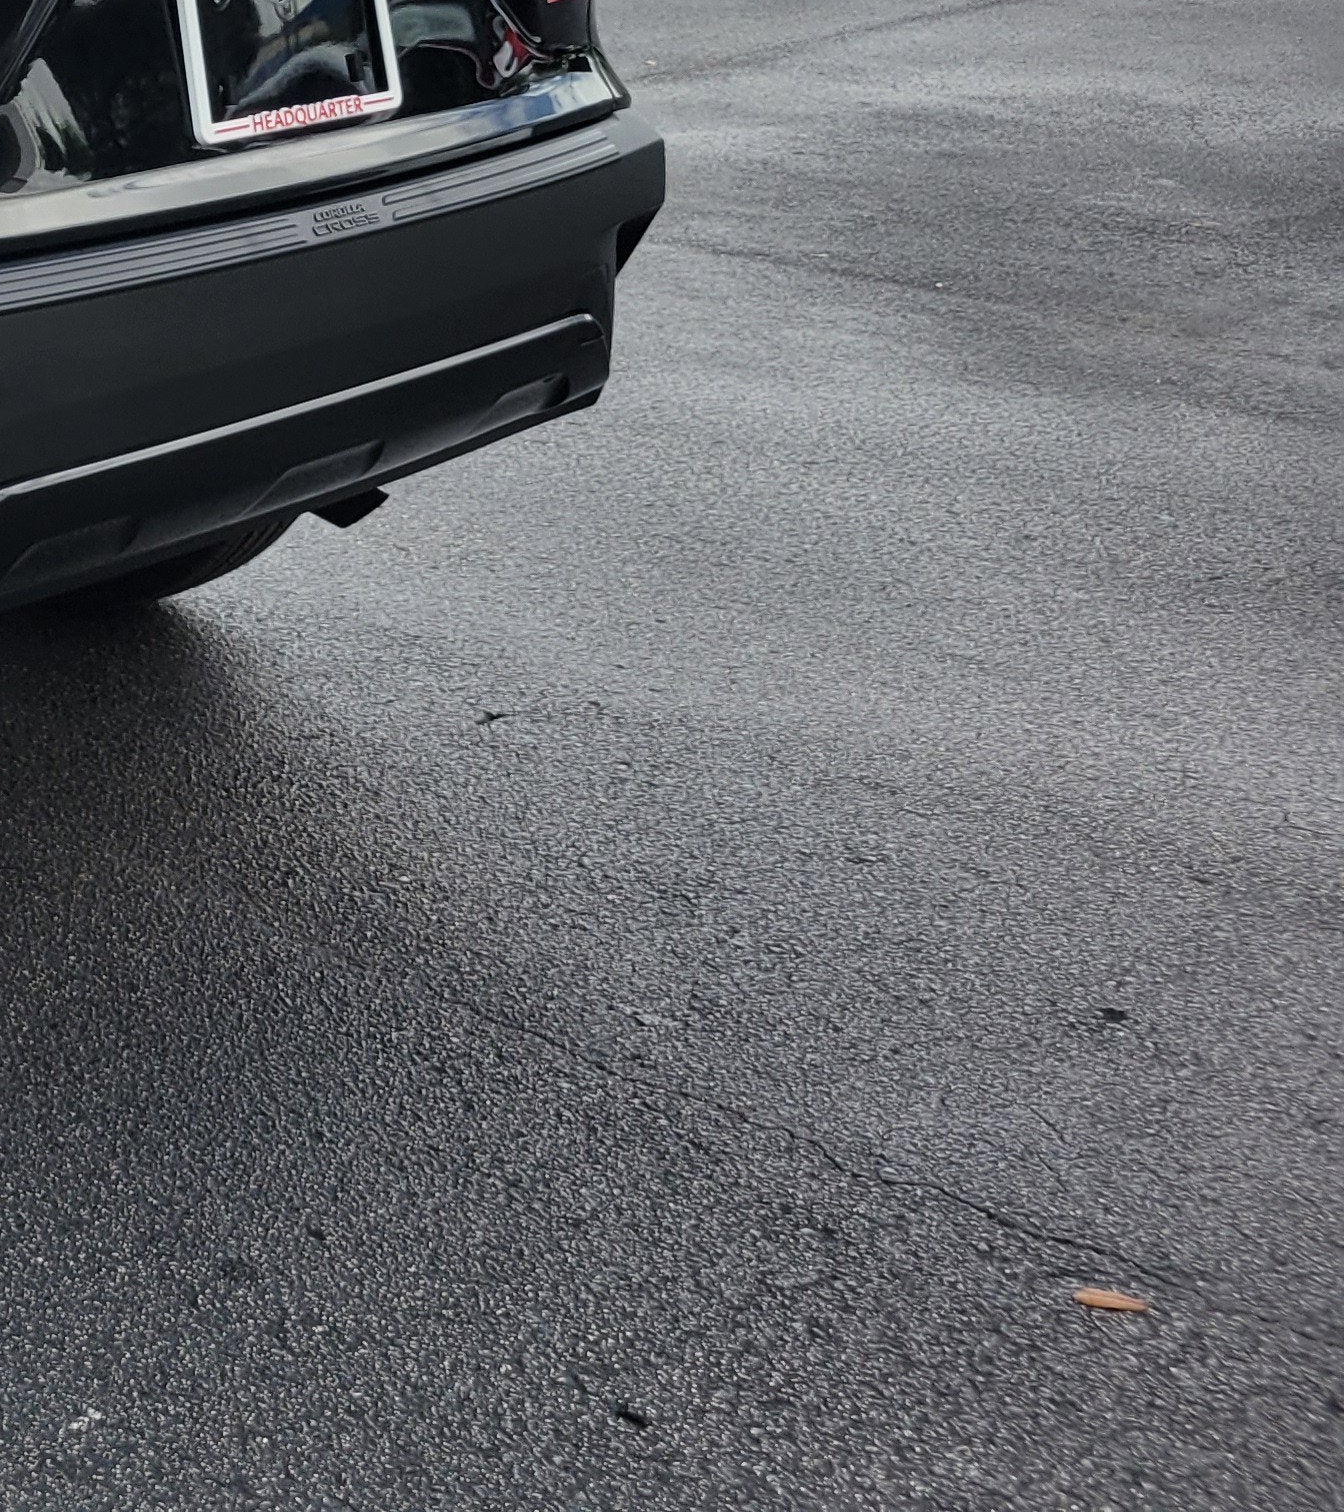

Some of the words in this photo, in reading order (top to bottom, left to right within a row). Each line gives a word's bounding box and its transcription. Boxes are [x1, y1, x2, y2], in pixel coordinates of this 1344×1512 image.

[252, 95, 364, 133] HEADQUARTER
[313, 203, 366, 222] COROLLA
[312, 213, 380, 237] CROSS
